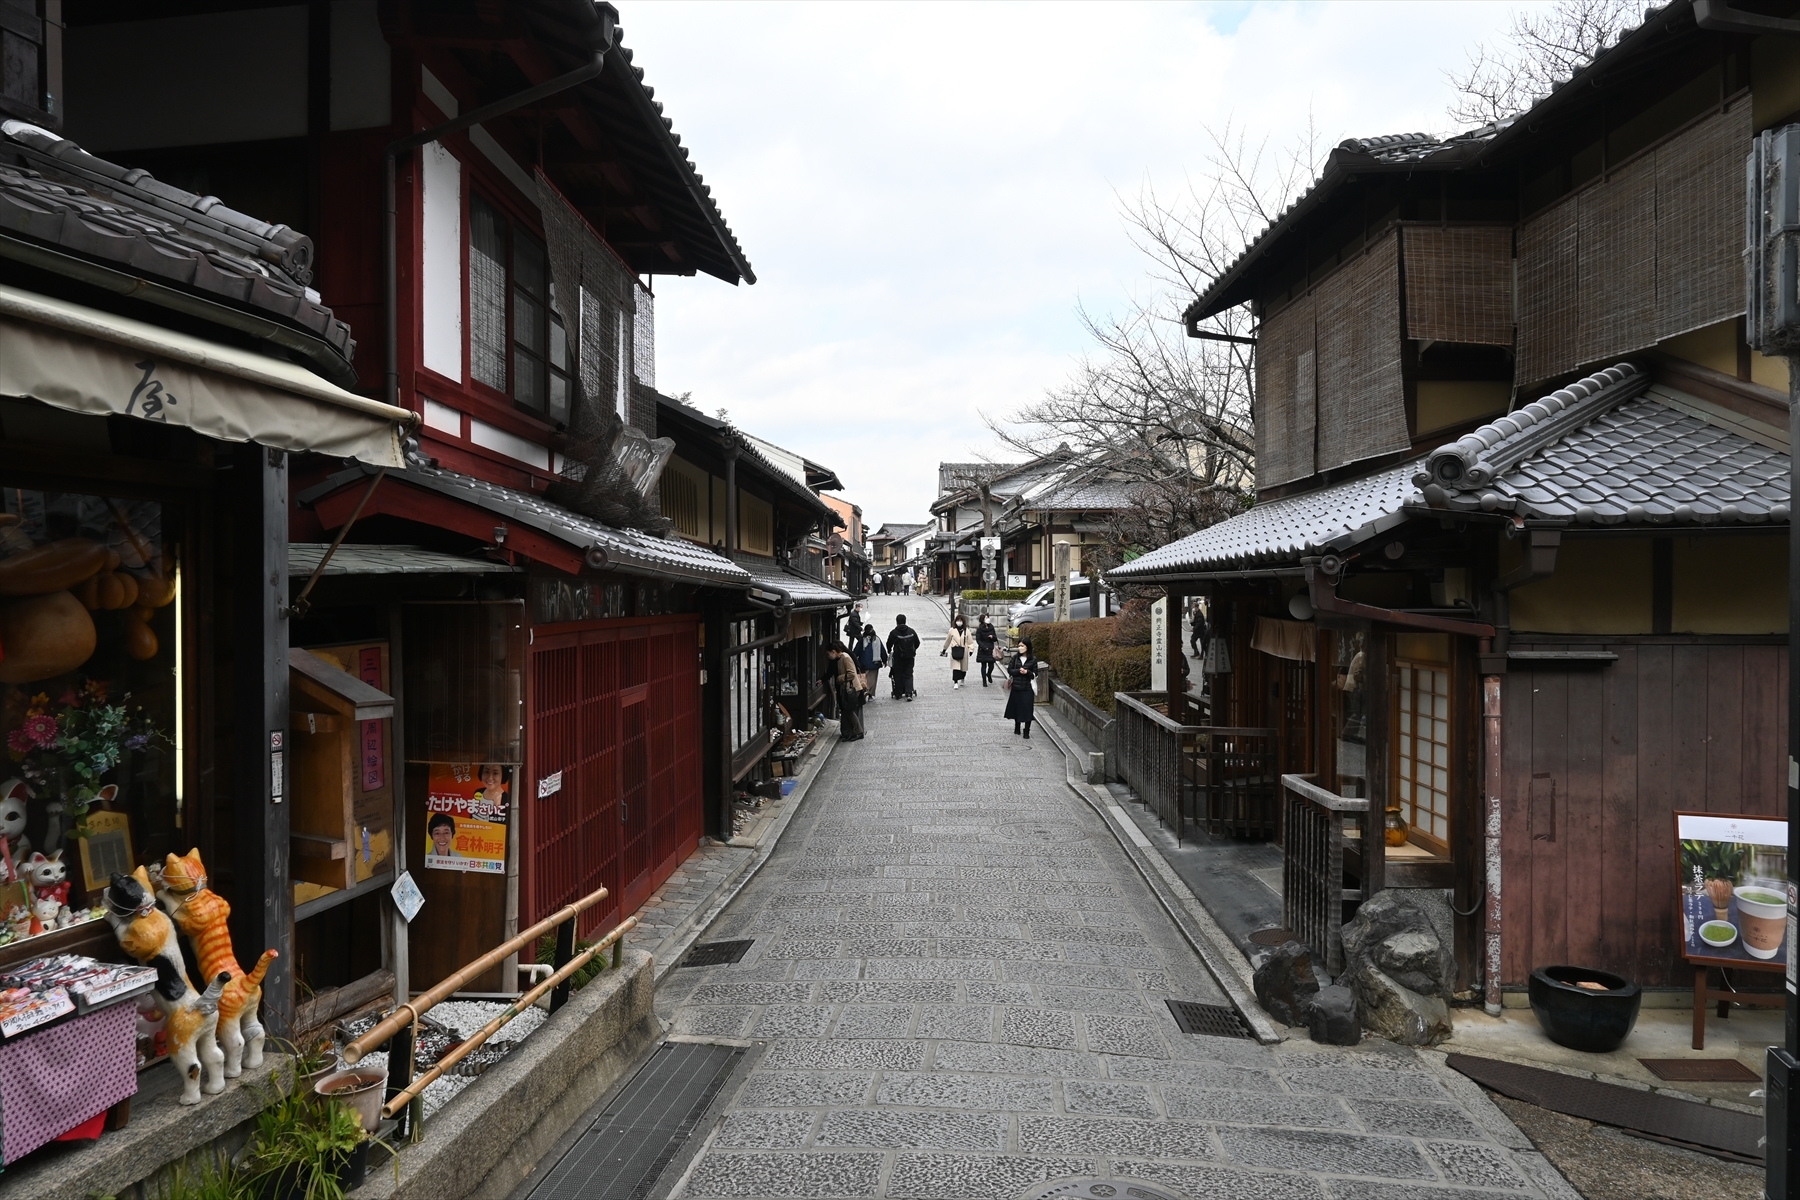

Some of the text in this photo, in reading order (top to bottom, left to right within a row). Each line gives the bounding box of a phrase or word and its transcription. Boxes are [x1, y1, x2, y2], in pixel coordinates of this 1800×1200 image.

[428, 796, 506, 816] たけやまさいこ
[455, 835, 504, 854] 倉林明子
[469, 860, 502, 870] 日本共産党
[1692, 865, 1705, 900] 抹茶ラテ
